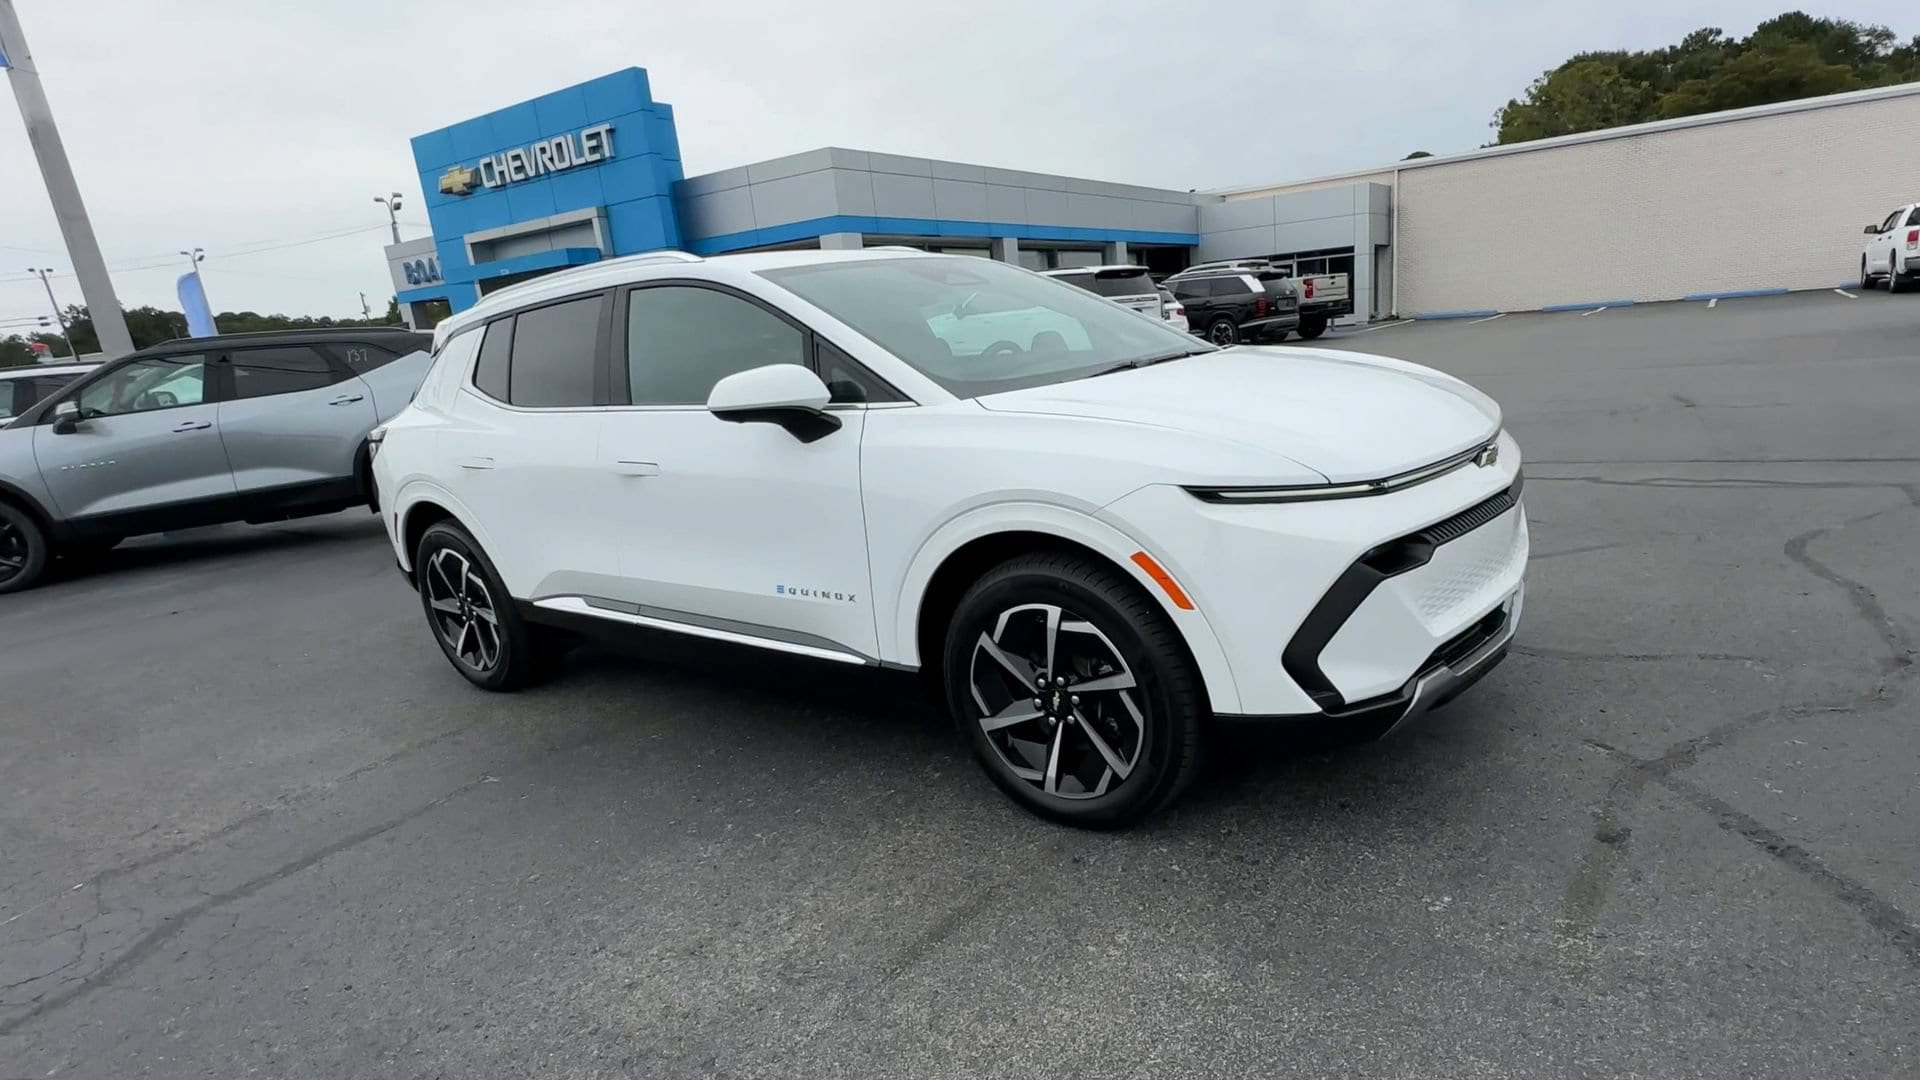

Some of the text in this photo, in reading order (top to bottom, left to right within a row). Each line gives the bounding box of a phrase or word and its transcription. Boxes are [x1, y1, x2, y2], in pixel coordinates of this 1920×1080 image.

[479, 123, 615, 188] CHEVROLET
[403, 256, 444, 285] BOA
[346, 348, 368, 363] 137
[776, 584, 857, 602] EQUINOX
